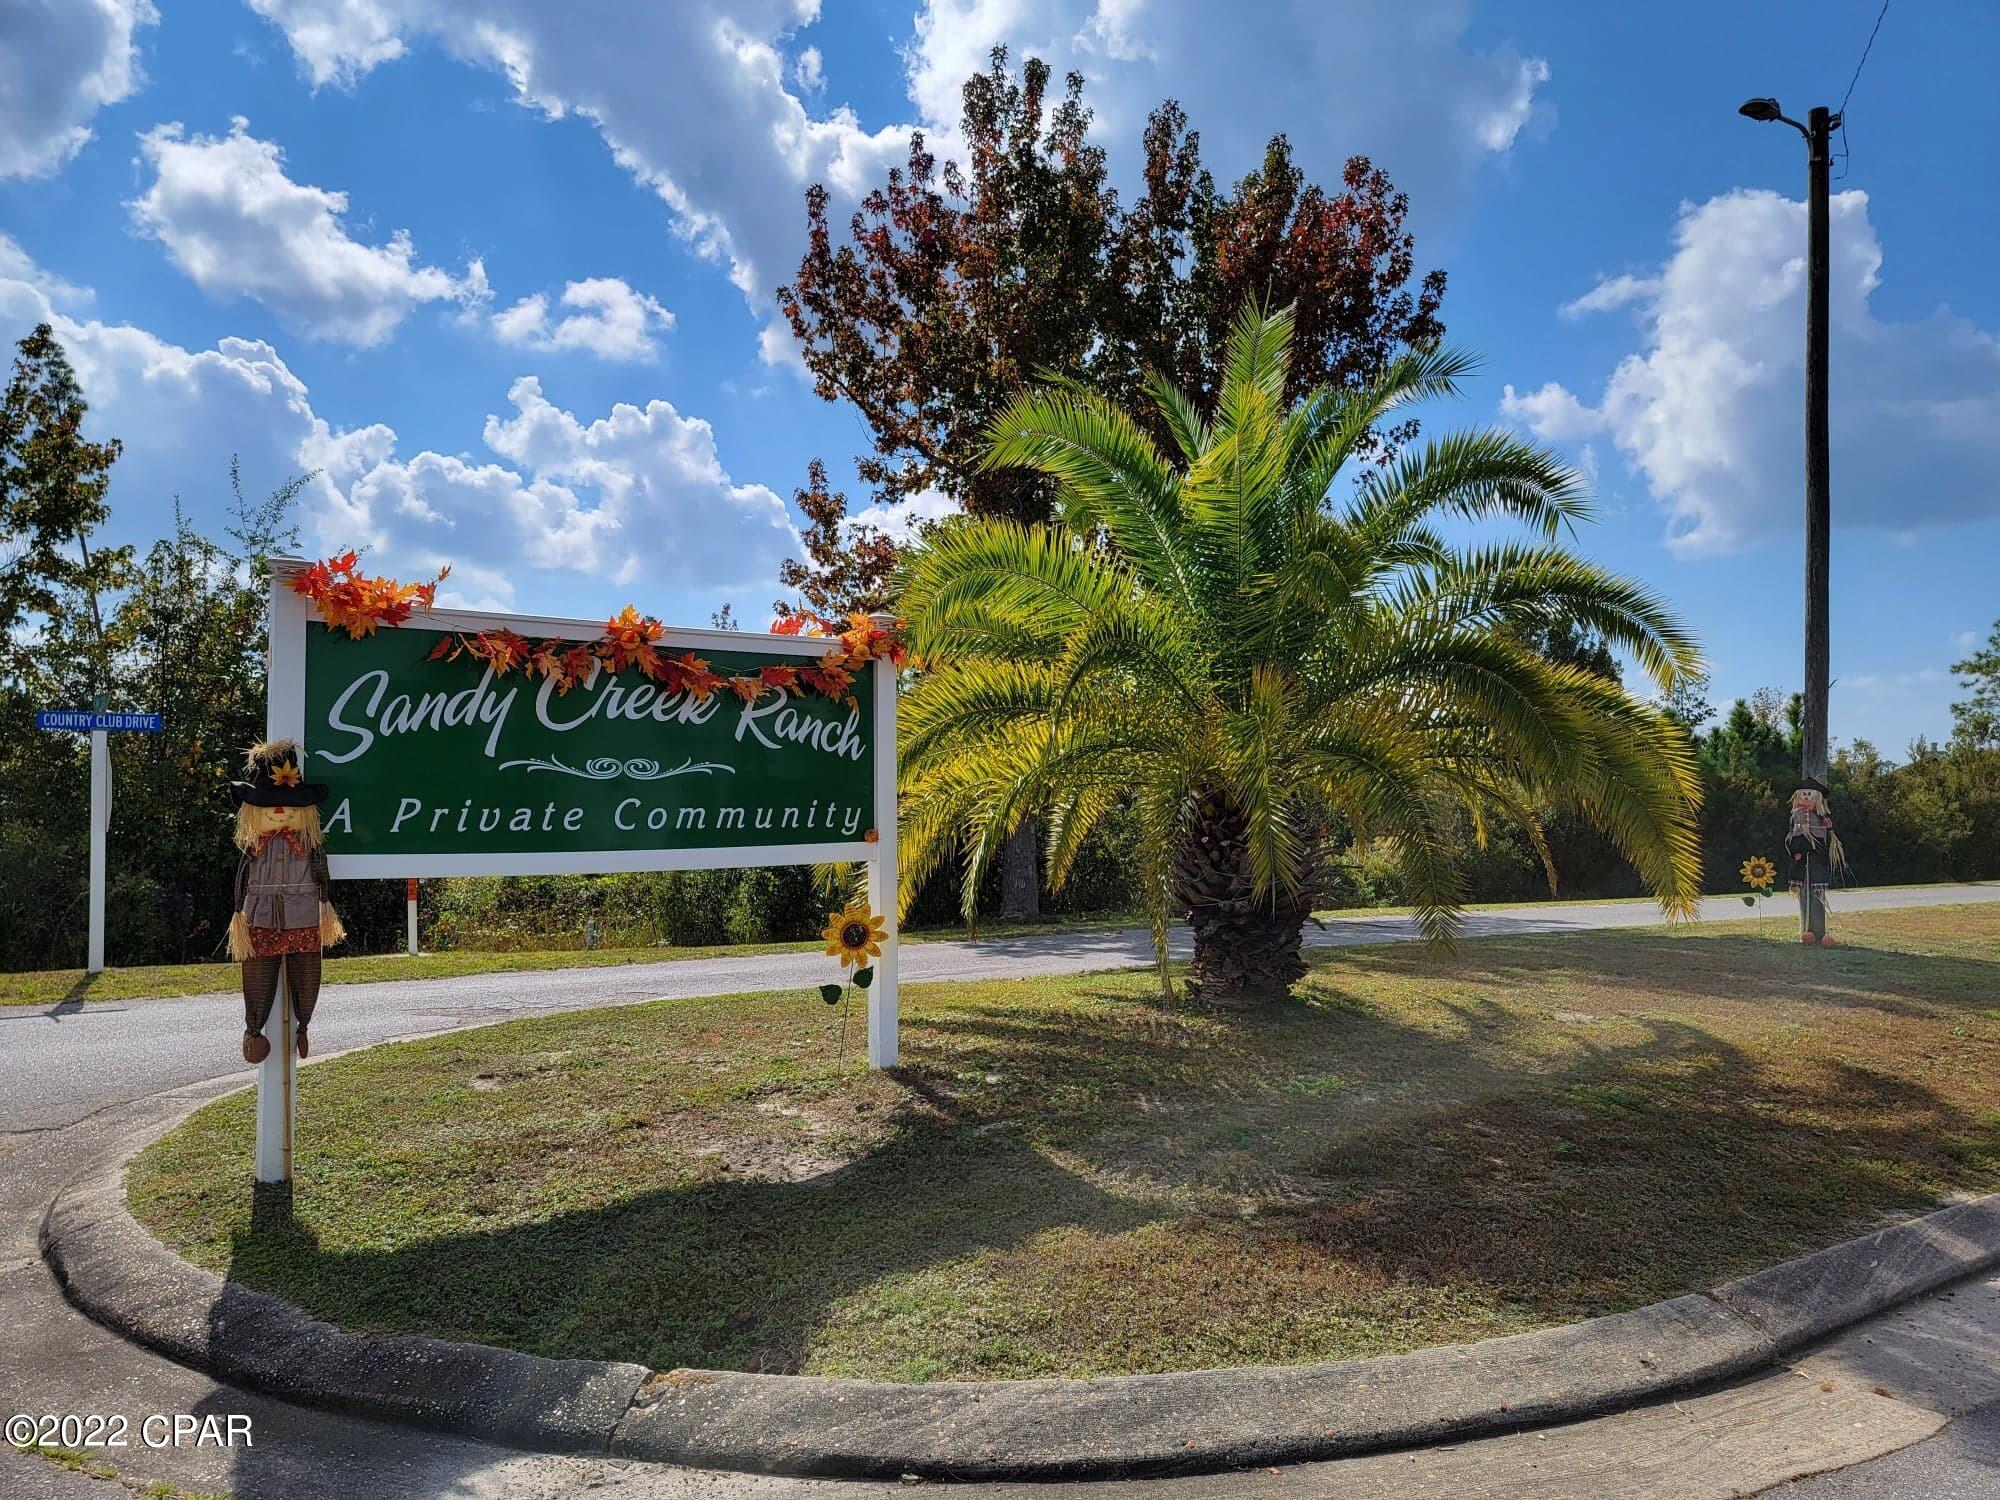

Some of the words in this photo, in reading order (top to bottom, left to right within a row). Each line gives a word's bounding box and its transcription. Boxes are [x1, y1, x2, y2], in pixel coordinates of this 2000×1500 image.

[43, 713, 93, 728] COUNTRY
[96, 715, 123, 728] CLUB
[125, 716, 156, 729] DRIVE
[315, 661, 518, 764] Sandy
[535, 655, 721, 732] Creek
[729, 677, 866, 761] Ranch
[323, 798, 353, 833] A
[390, 798, 584, 833] Private
[614, 797, 862, 836] Community
